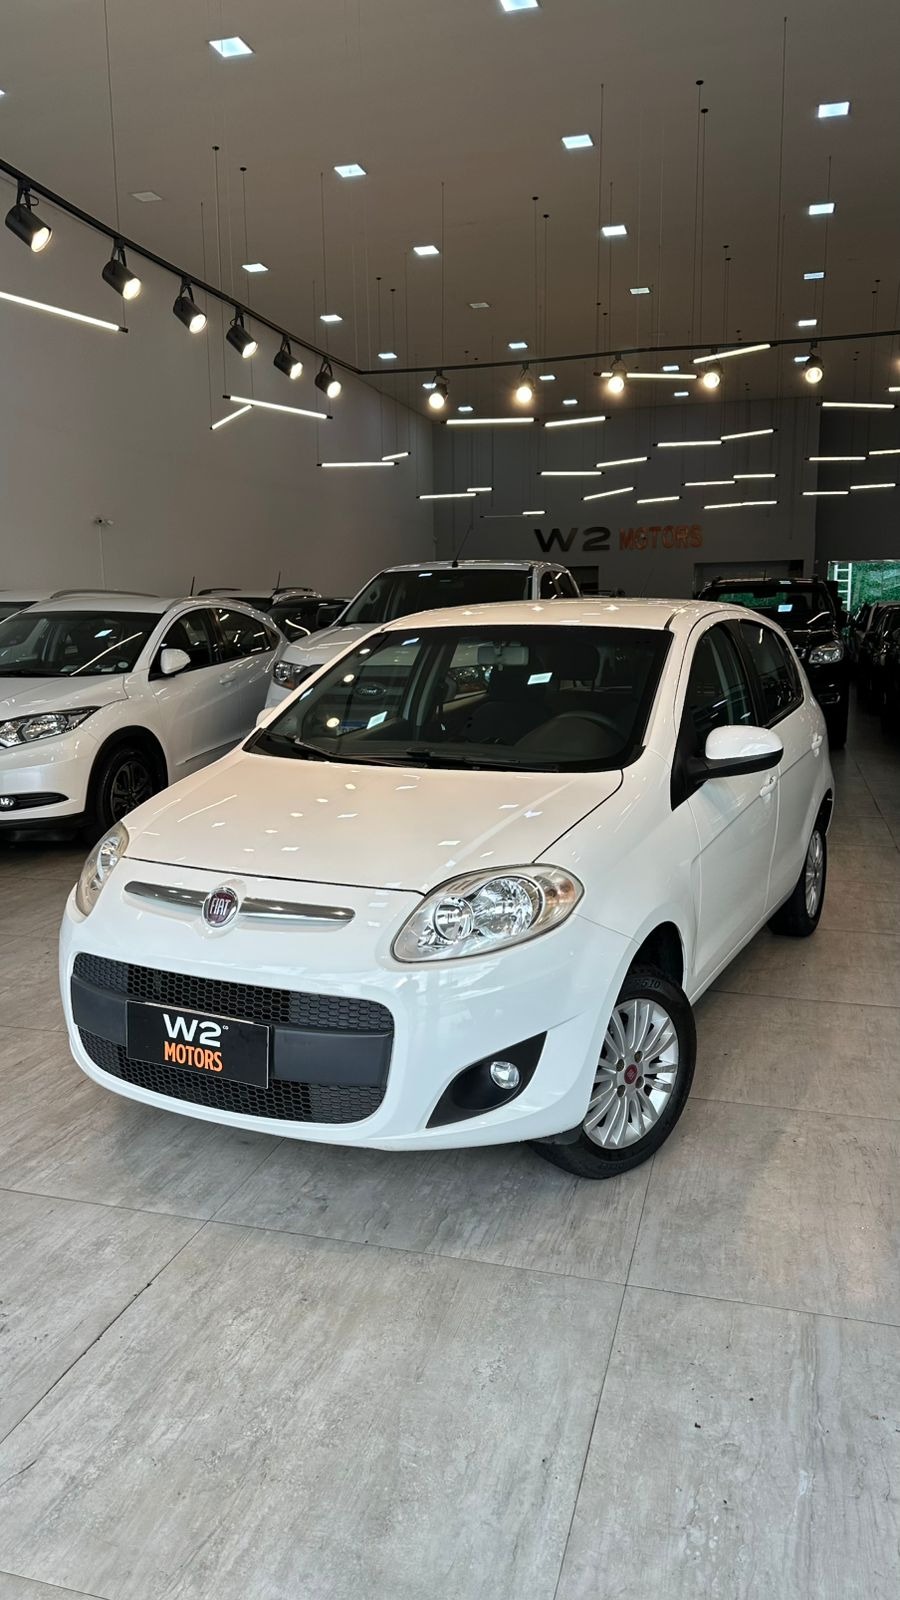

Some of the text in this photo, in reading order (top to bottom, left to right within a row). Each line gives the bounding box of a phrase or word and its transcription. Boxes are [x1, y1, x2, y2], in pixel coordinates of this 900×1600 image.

[534, 525, 703, 552] W2 MOTORS
[210, 897, 231, 916] FIAT
[163, 1013, 222, 1047] W2
[164, 1041, 223, 1072] MOTORS
